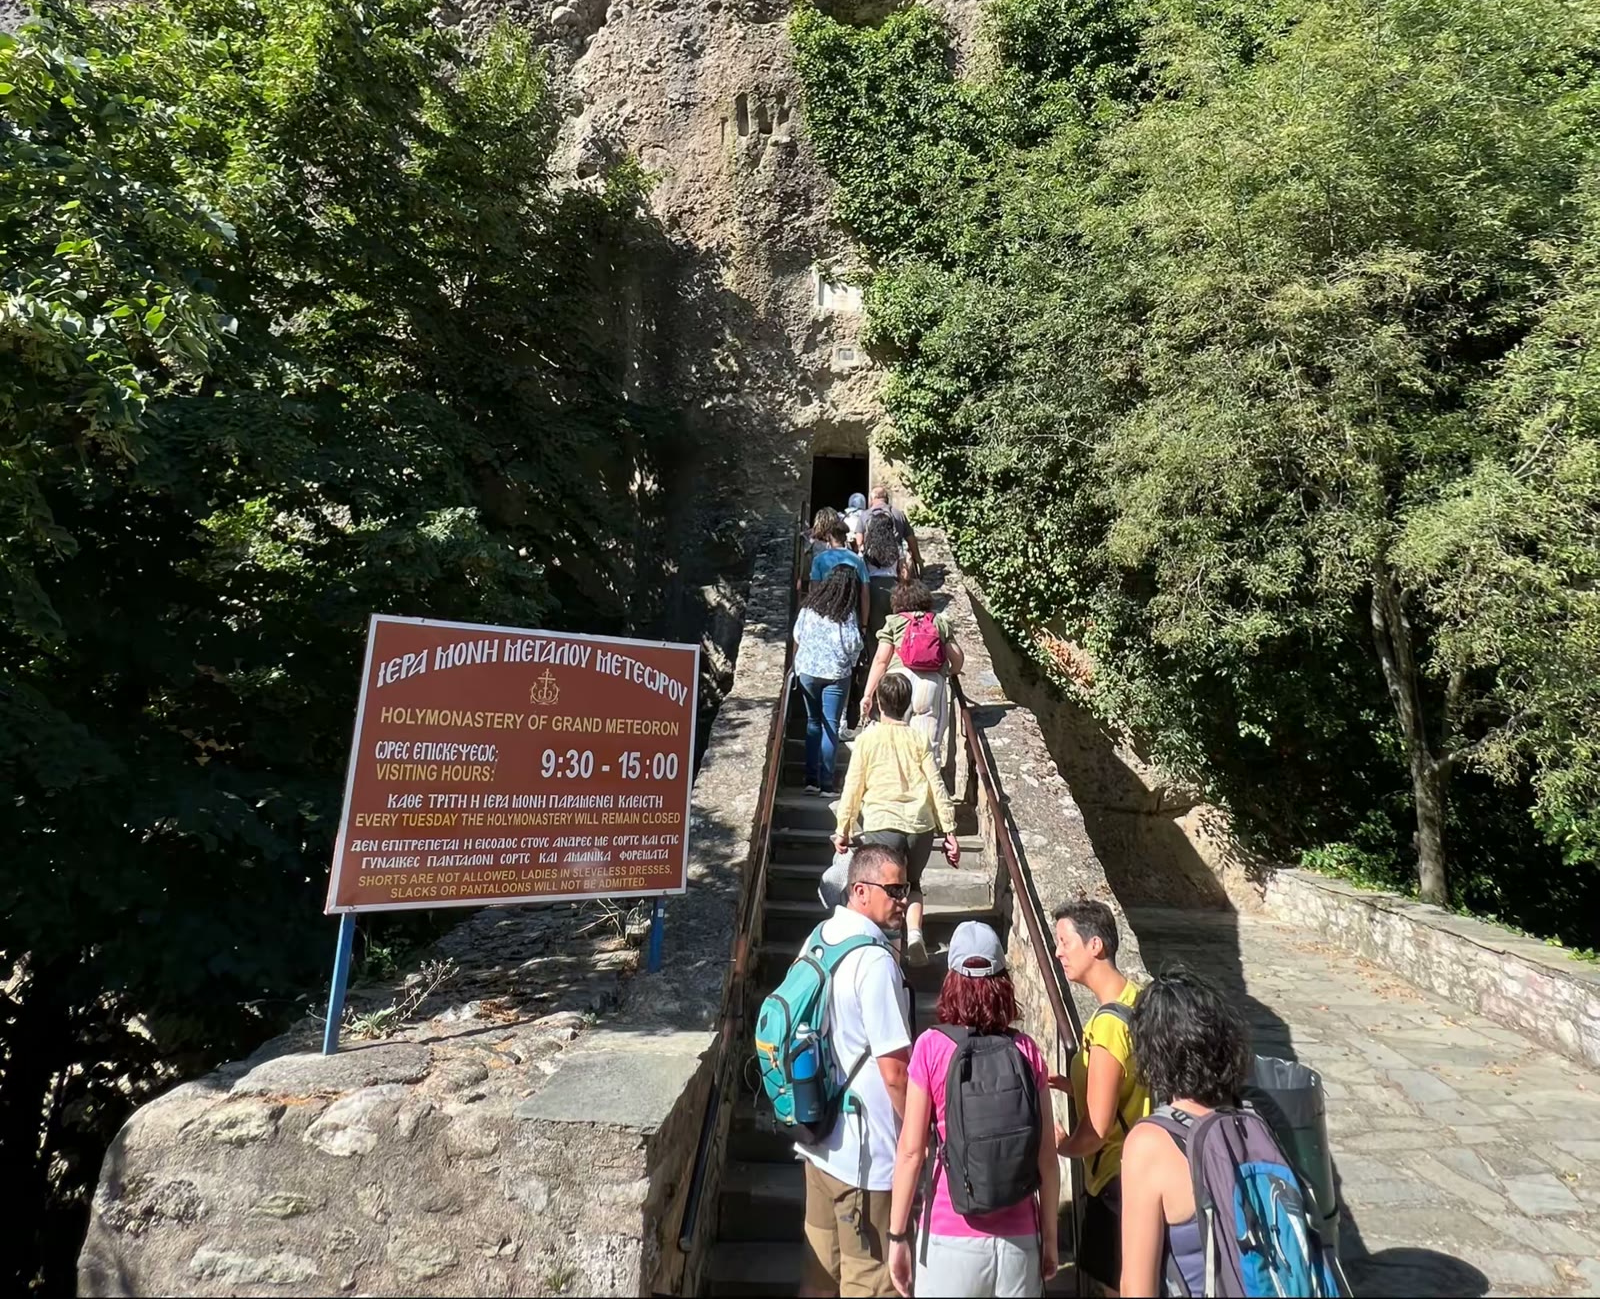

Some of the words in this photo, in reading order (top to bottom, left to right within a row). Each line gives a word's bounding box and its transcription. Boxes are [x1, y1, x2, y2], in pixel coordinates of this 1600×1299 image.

[376, 649, 428, 688] ΙΕΡΑ
[434, 639, 499, 671] ΜΟΝΗ
[503, 638, 593, 668] ΜΕΓΑΛΟΥ
[596, 649, 688, 707] ΜΕΤΕΩΡΟΥ
[380, 706, 524, 729] HOLYMONASTERY
[527, 714, 548, 731] OF
[551, 715, 602, 733] GRAND
[605, 717, 680, 736] METEORON
[375, 763, 438, 781] VISITING
[441, 764, 496, 782] HOURS:
[540, 748, 595, 780] 9:30
[618, 751, 680, 781] 15:00
[387, 793, 424, 809] ΚΑΘΕ
[428, 794, 467, 809] ΤΡΙΤΗ
[470, 794, 480, 809] Η
[483, 794, 509, 809] ΙΕΡΑ
[512, 794, 546, 808] ΜΟΝΗ
[549, 794, 613, 809] ΠΑΡΑΜΕΝΕΙ
[355, 813, 399, 827] EVERY
[402, 813, 458, 827] TUESDAY
[461, 813, 484, 826] THE
[487, 812, 574, 826] HOLYMONASTERY
[574, 812, 599, 825] WILL
[601, 812, 640, 825] REMAIN
[642, 812, 681, 824] CLOSED
[351, 839, 378, 852] ΔΕΝ
[381, 839, 459, 851] ΕΠΙΤΡΕΠΕΤΑΙ
[463, 838, 473, 850] Η
[594, 836, 609, 847] ΜΕ
[641, 835, 658, 845] ΚΑΙ
[426, 854, 494, 867] ΠΑΝΤΑΛΟΝΙ
[538, 852, 557, 864] ΚΑΙ
[563, 850, 612, 863] ΑΜΑΝΙΚΑ
[619, 849, 669, 861] ΦΟΡΕΜΑΤΑ
[358, 874, 407, 887] SHORTS
[409, 873, 434, 884] ARE
[437, 872, 460, 883] NOT
[462, 870, 518, 882] ALLOWED,
[521, 868, 558, 880] LADIES
[560, 867, 570, 878] IN
[572, 866, 627, 878] SLEVELESS
[390, 886, 437, 899] SLACKS
[440, 885, 457, 896] OR
[459, 881, 531, 896] PANTALOONS
[534, 880, 558, 892] WILL
[560, 879, 581, 890] NOT
[584, 879, 596, 889] BE
[599, 877, 647, 888] ADMITTED.
